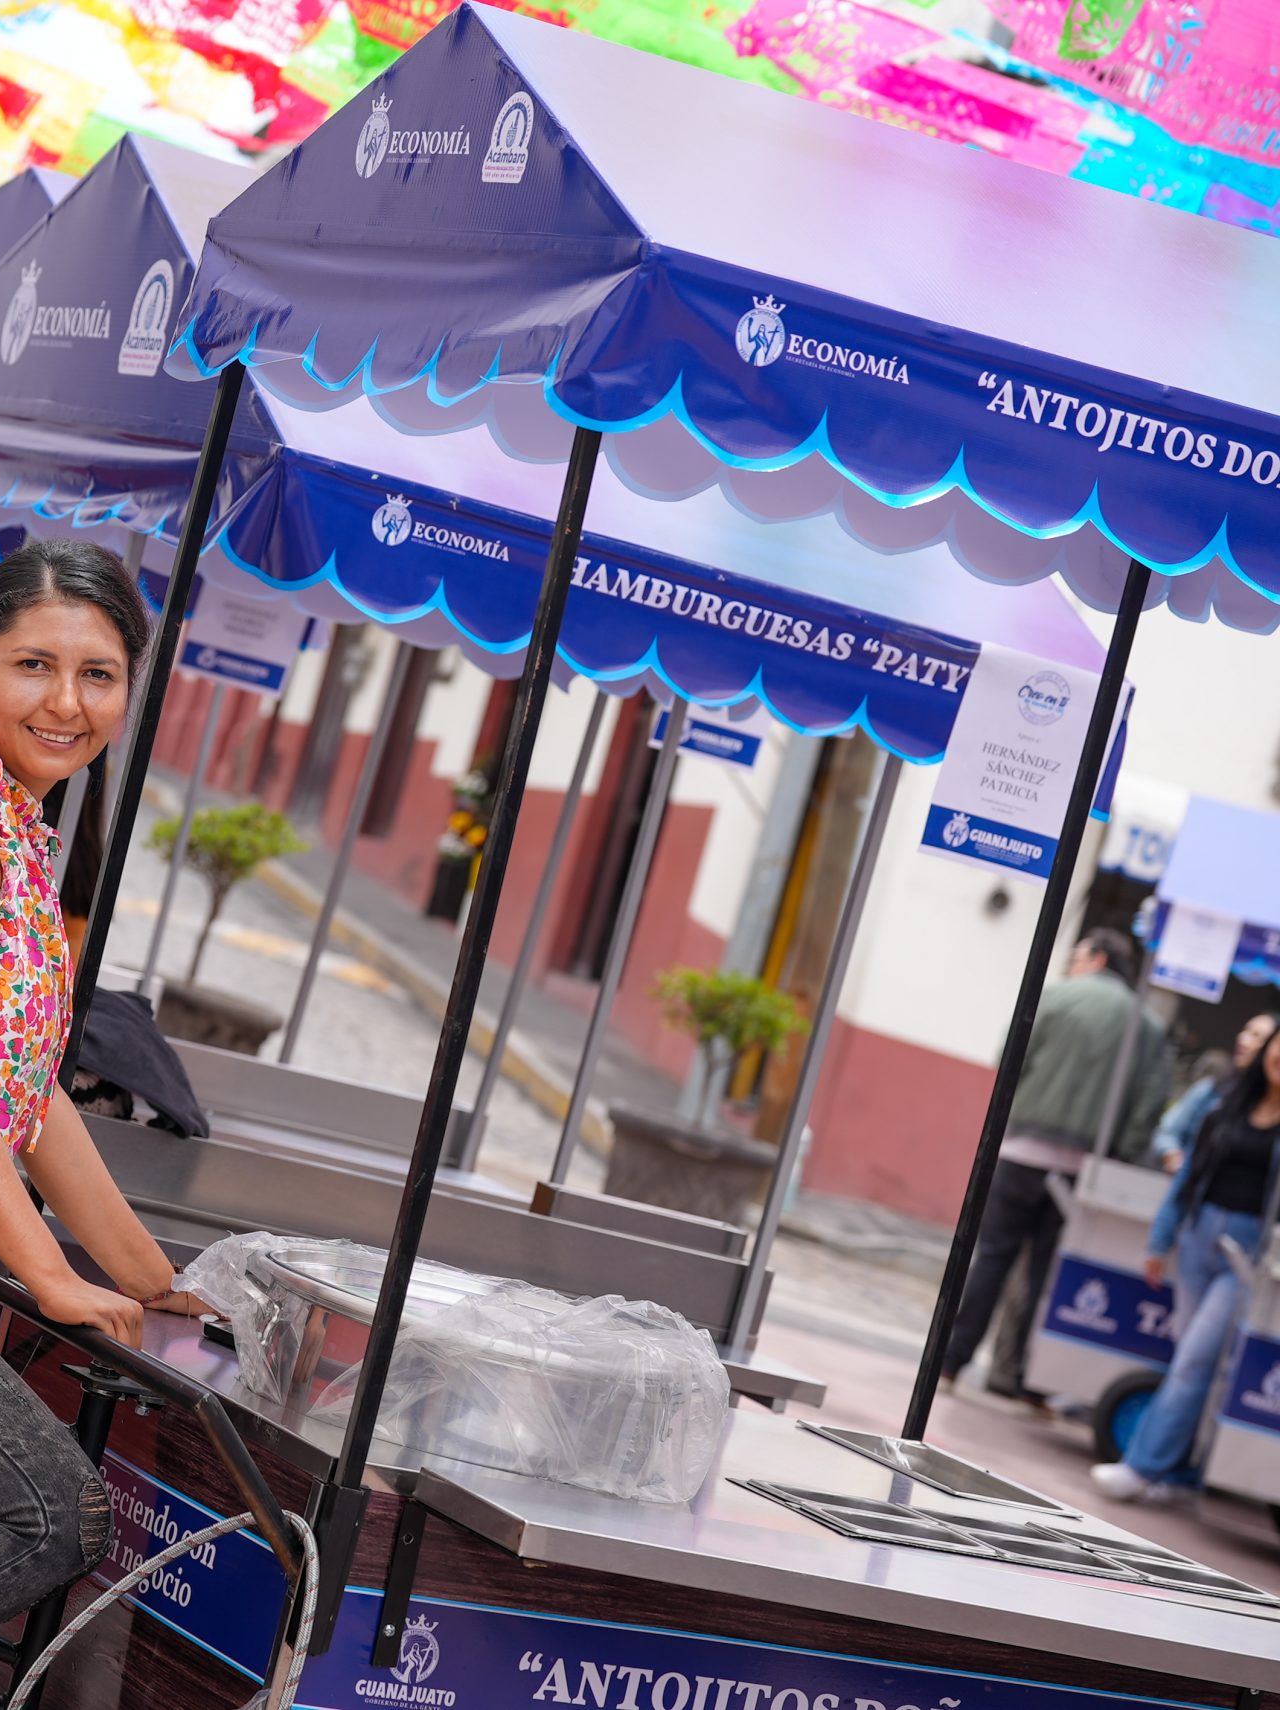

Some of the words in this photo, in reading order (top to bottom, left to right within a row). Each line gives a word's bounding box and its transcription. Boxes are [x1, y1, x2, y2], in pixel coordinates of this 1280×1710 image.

[388, 125, 470, 155] ECONOMÍA
[486, 148, 526, 163] Acámbaro
[32, 300, 111, 339] ECONOMÍA
[787, 333, 910, 385] ECONOMÍA
[1219, 440, 1280, 489] DO
[412, 521, 510, 562] ECONOMÍA
[570, 555, 856, 661] HAMBURGUESAS
[982, 741, 1061, 774] HERNÁNDEZ
[985, 760, 1046, 787] SÁNCHEZ
[980, 776, 1038, 802] PATRICIA
[969, 828, 1043, 860] GUANAJUATO
[355, 1679, 456, 1707] GUANAJUATO
[364, 1697, 399, 1708] GOBIERNO
